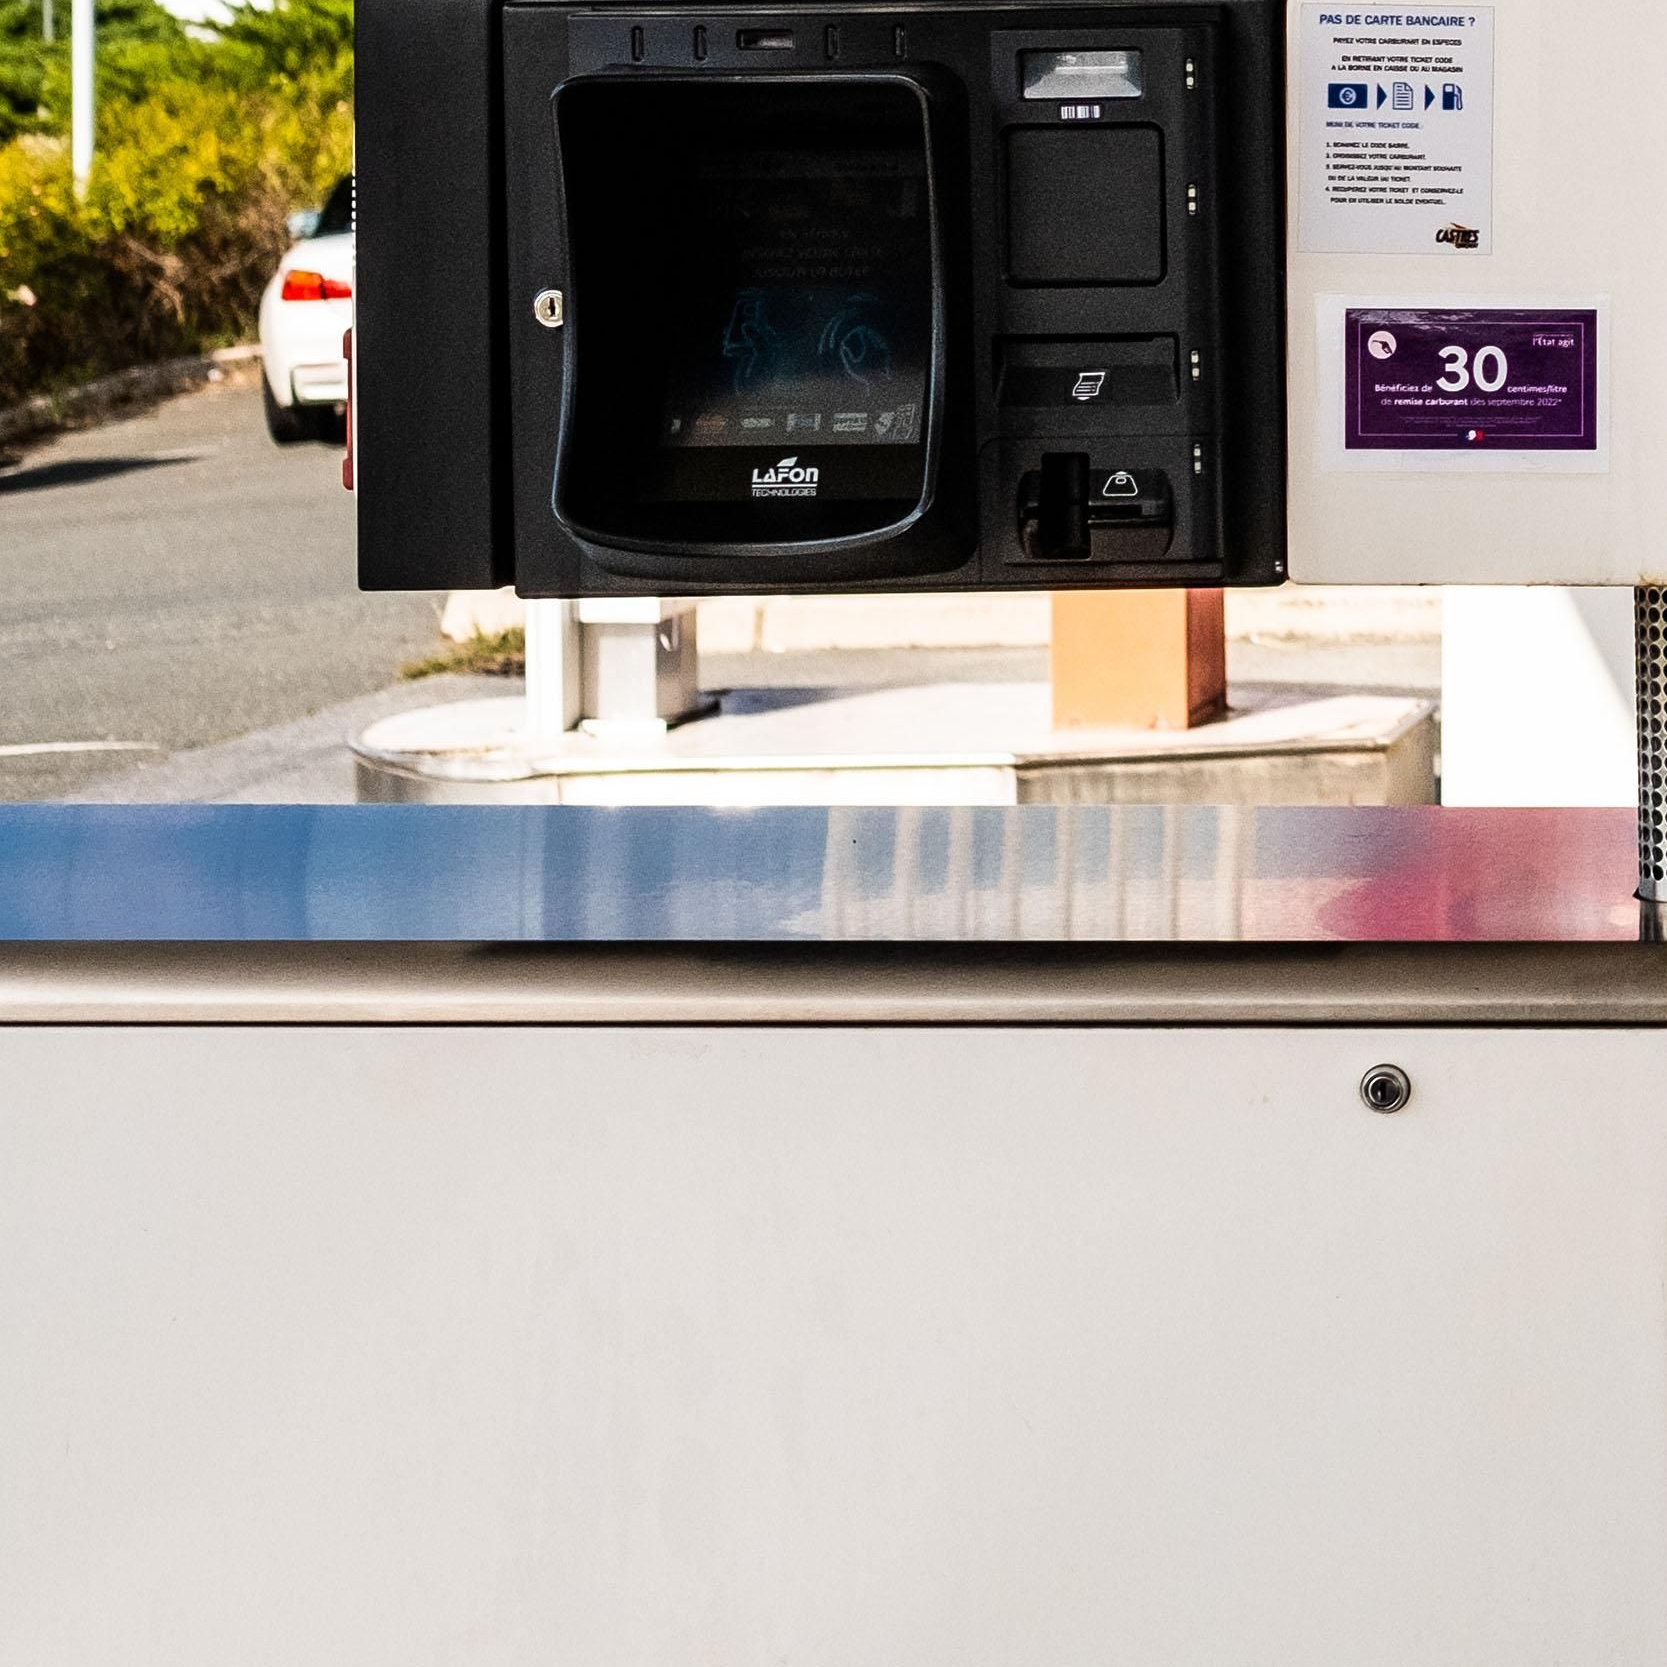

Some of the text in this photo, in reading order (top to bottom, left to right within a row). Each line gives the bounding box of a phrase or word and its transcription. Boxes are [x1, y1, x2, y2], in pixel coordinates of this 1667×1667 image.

[1319, 14, 1476, 27] PAS DE CARTE BANCAIRE ?
[1421, 384, 1433, 393] de
[1435, 345, 1508, 392] 30
[1394, 397, 1423, 406] remise
[1425, 397, 1468, 406] carburant
[752, 467, 819, 483] LAFON
[752, 488, 817, 497] TECHNOLOGIES
